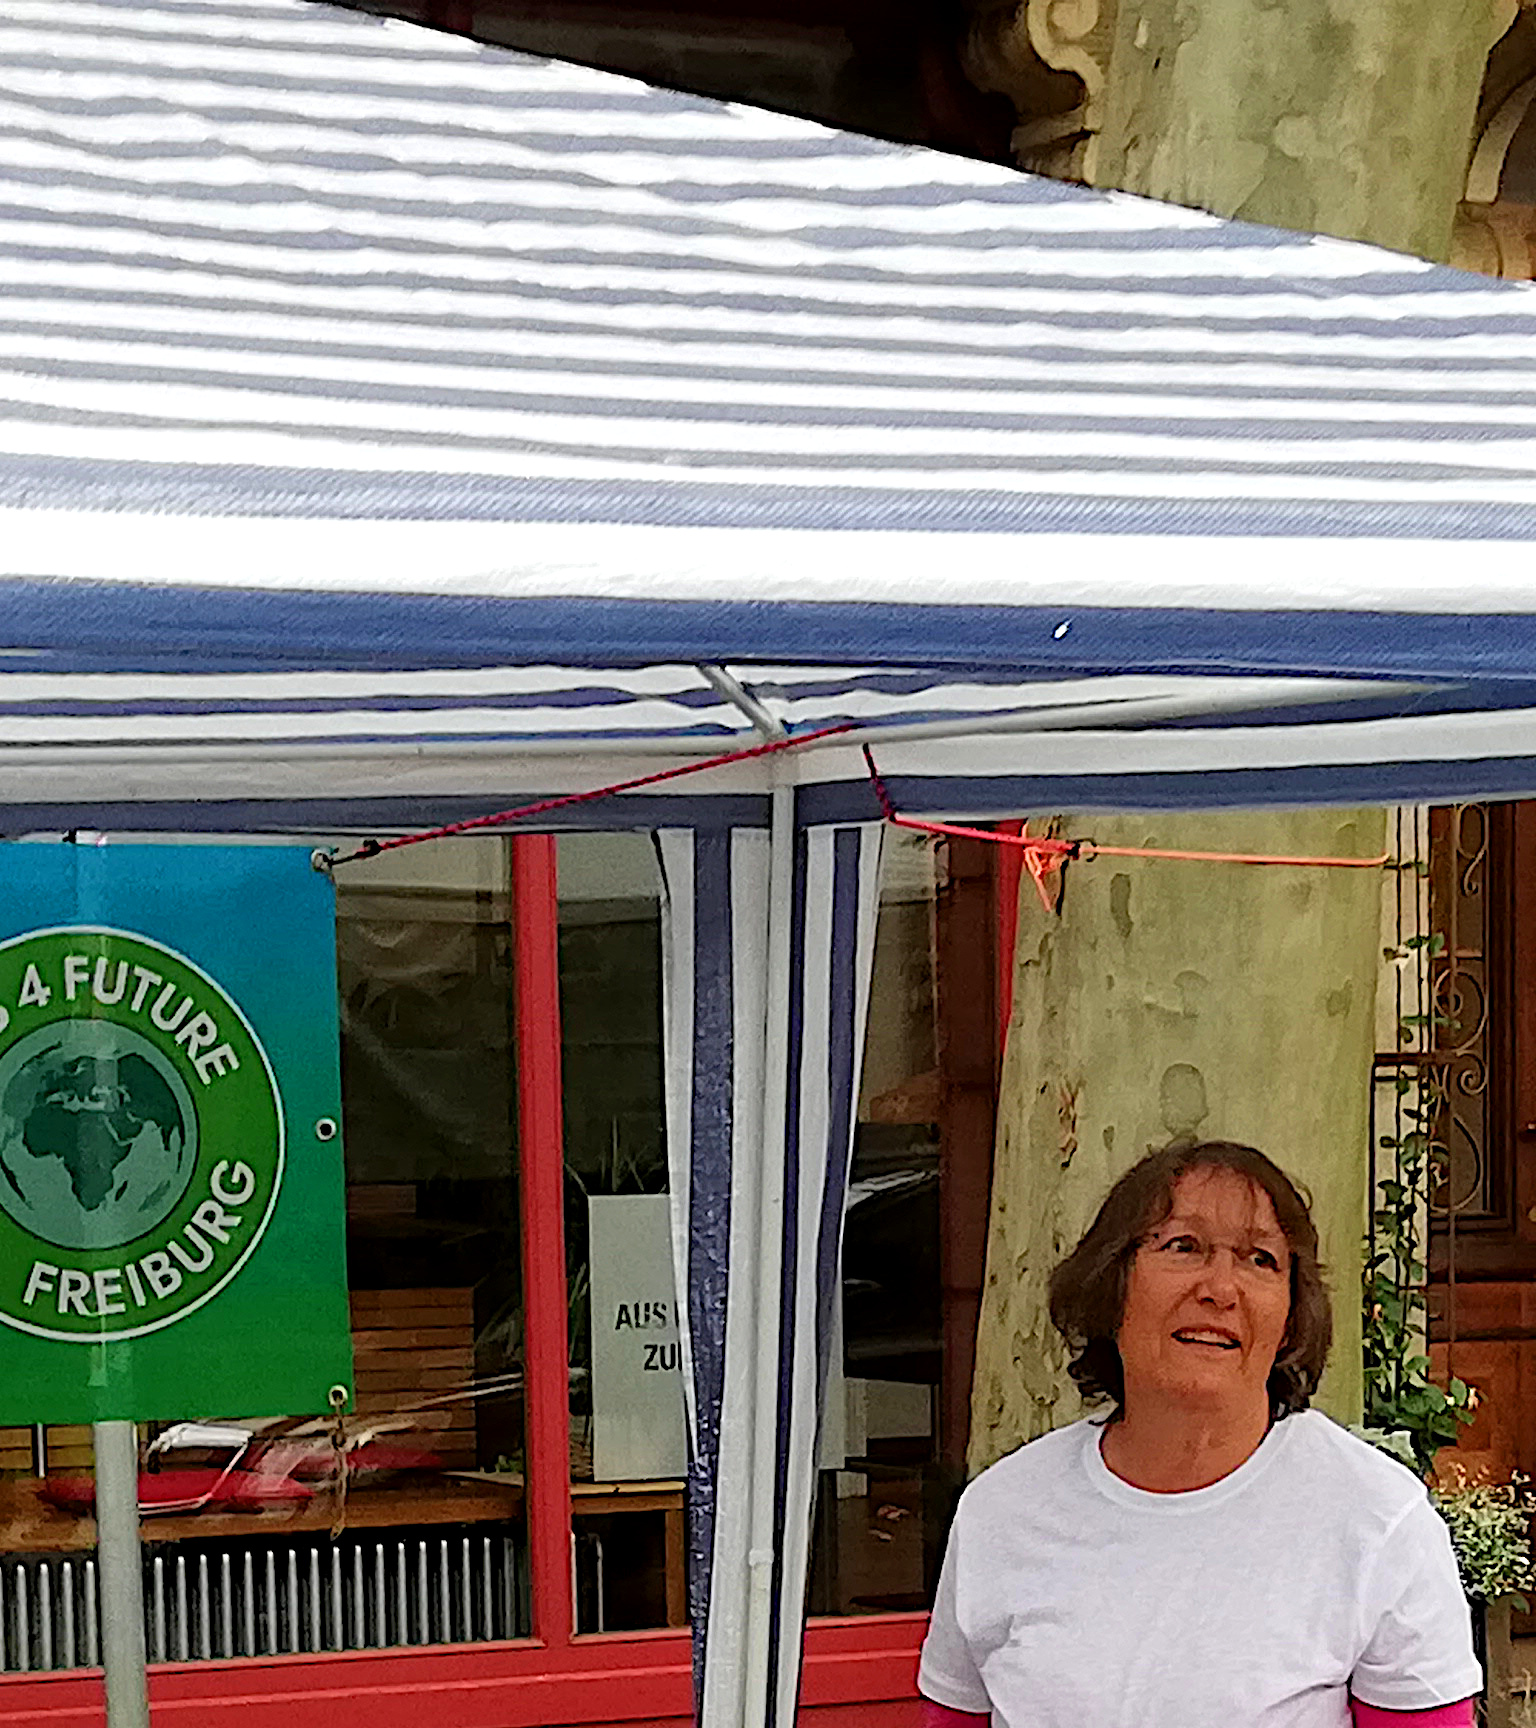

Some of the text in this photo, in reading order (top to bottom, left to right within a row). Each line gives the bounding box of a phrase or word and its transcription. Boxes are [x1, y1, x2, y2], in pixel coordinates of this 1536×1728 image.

[17, 964, 52, 1009] 4
[64, 953, 240, 1086] FUTURE
[22, 1158, 256, 1318] FREIBURG
[614, 1301, 668, 1331] AUS
[643, 1343, 683, 1372] ZU
